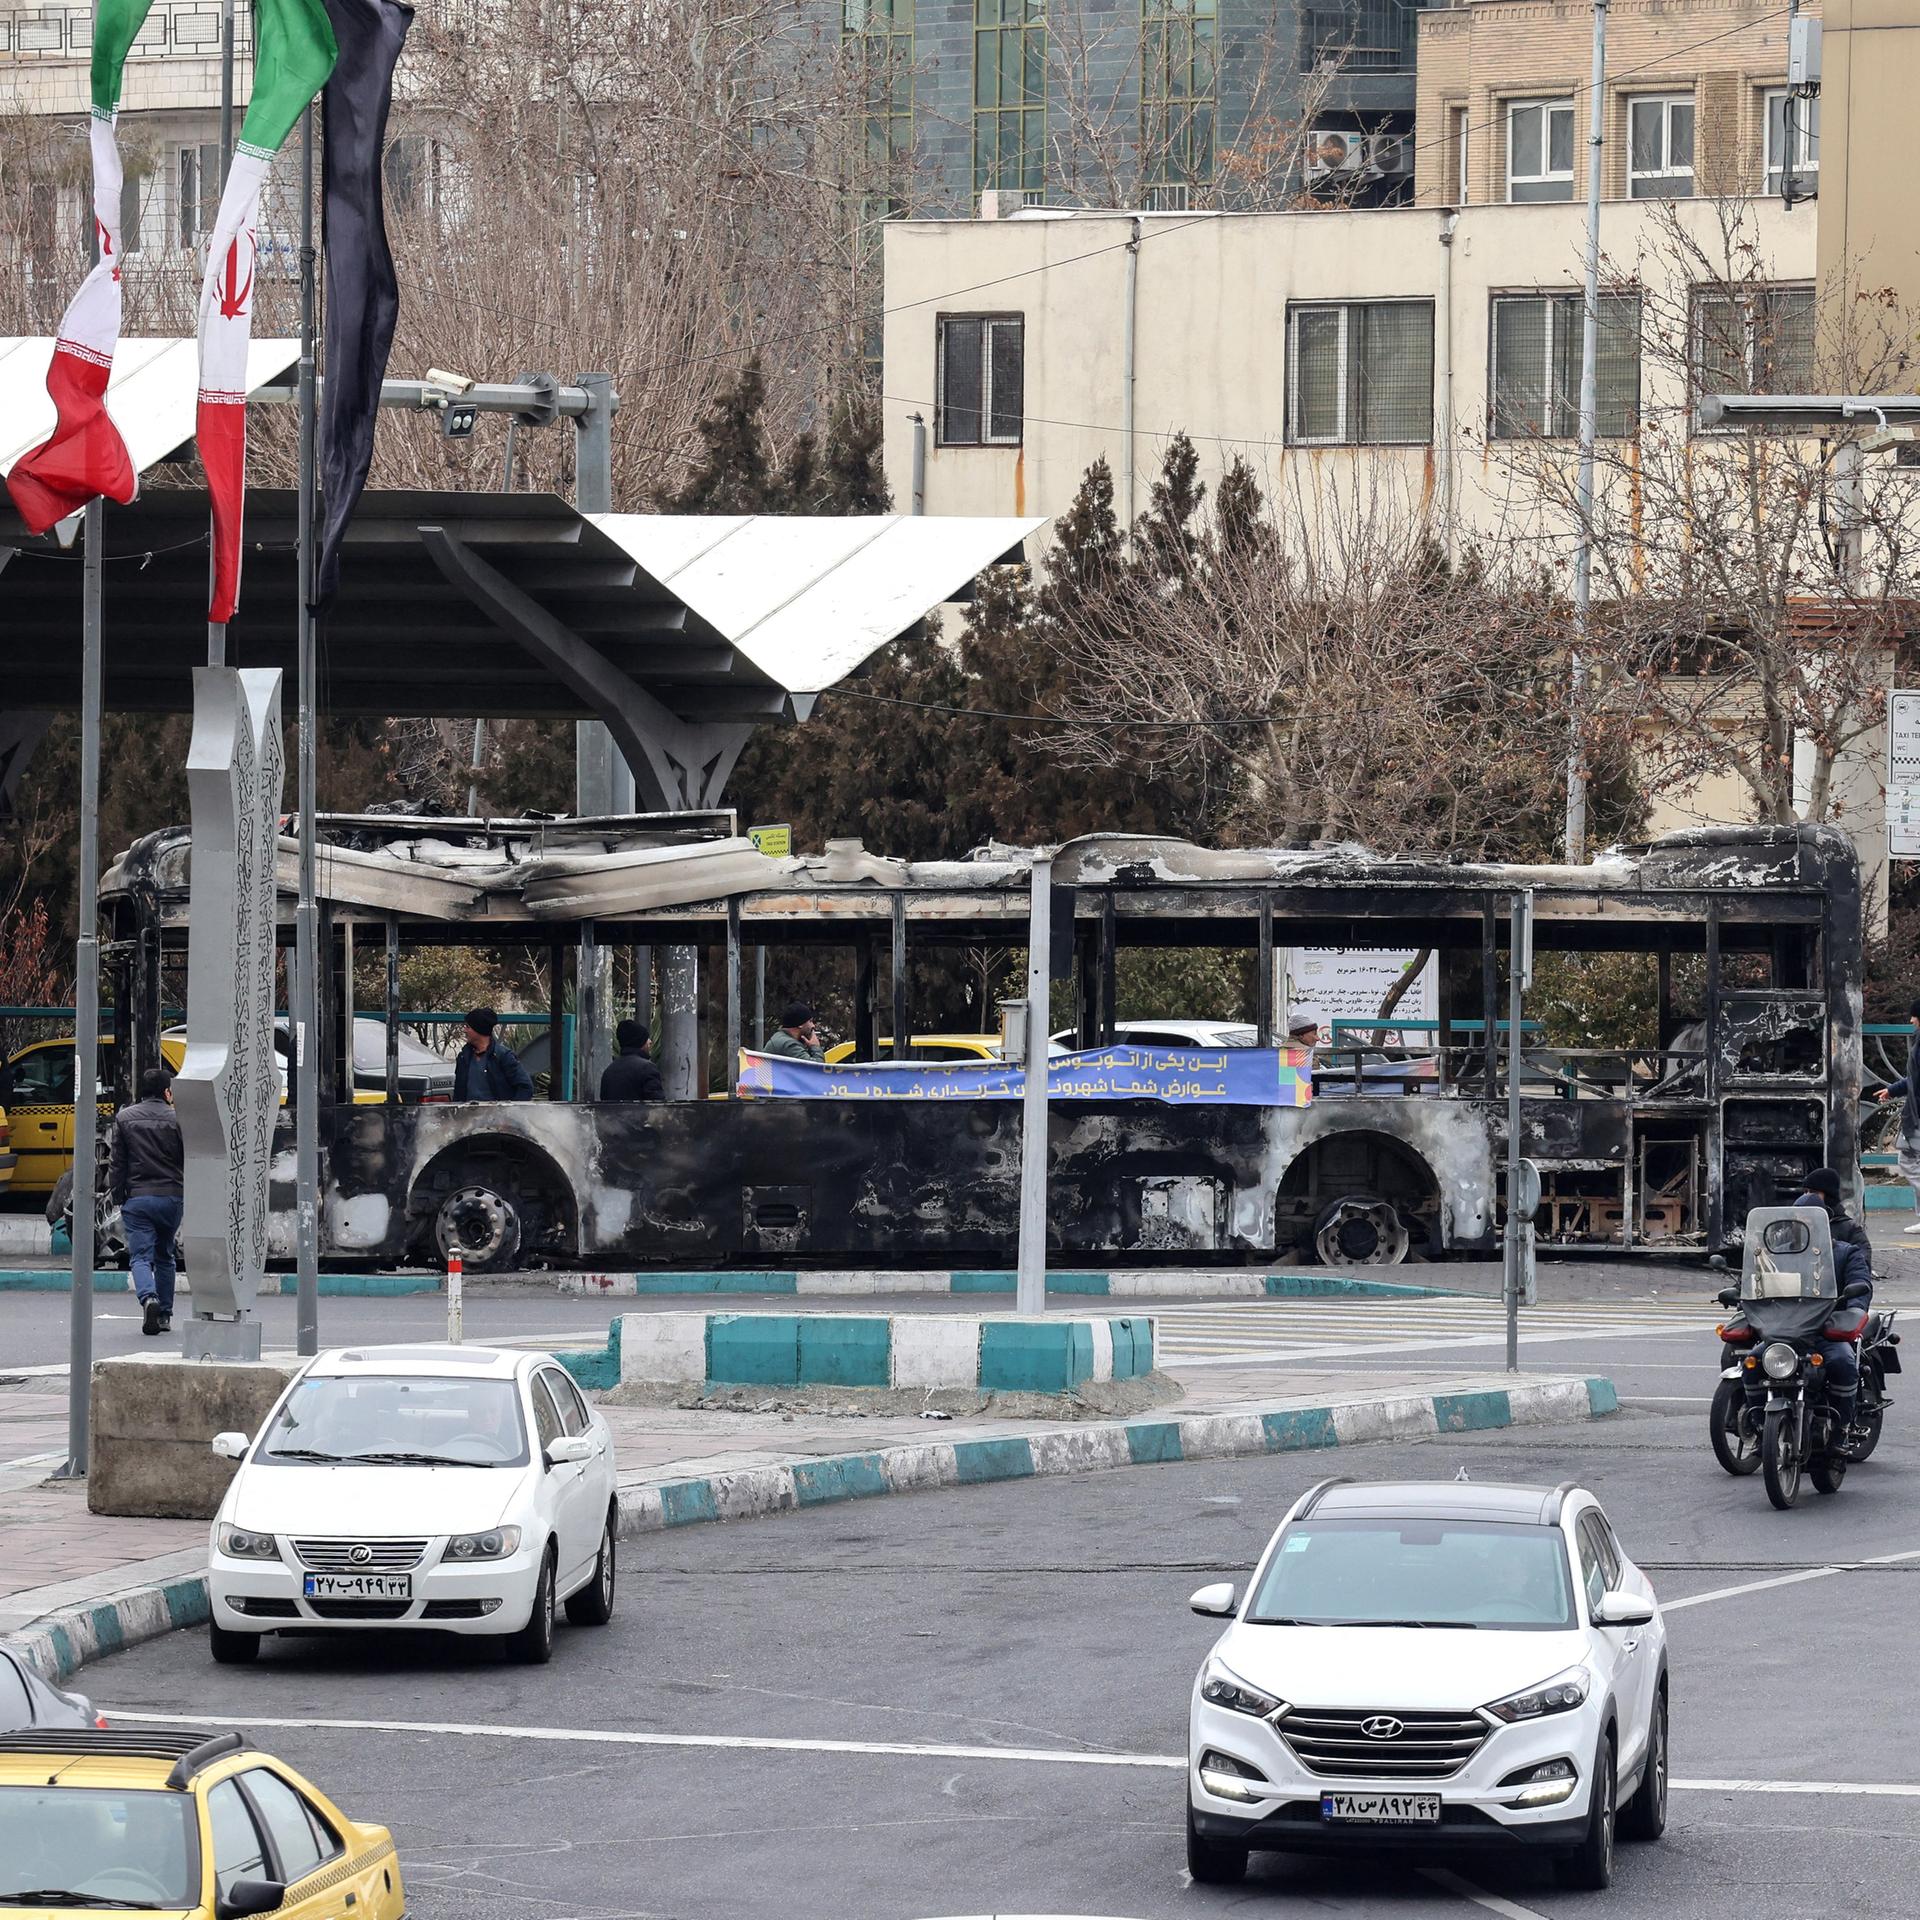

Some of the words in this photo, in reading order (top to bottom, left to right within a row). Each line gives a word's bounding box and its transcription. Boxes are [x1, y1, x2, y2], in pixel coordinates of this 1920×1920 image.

[1142, 1052, 1153, 1070] از
[1155, 1053, 1185, 1071] یکی
[1189, 1054, 1228, 1073] این
[874, 1082, 923, 1098] شده
[1111, 1078, 1158, 1094] شما
[1160, 1079, 1227, 1098] عوارض
[1417, 1801, 1438, 1818] ۴۴
